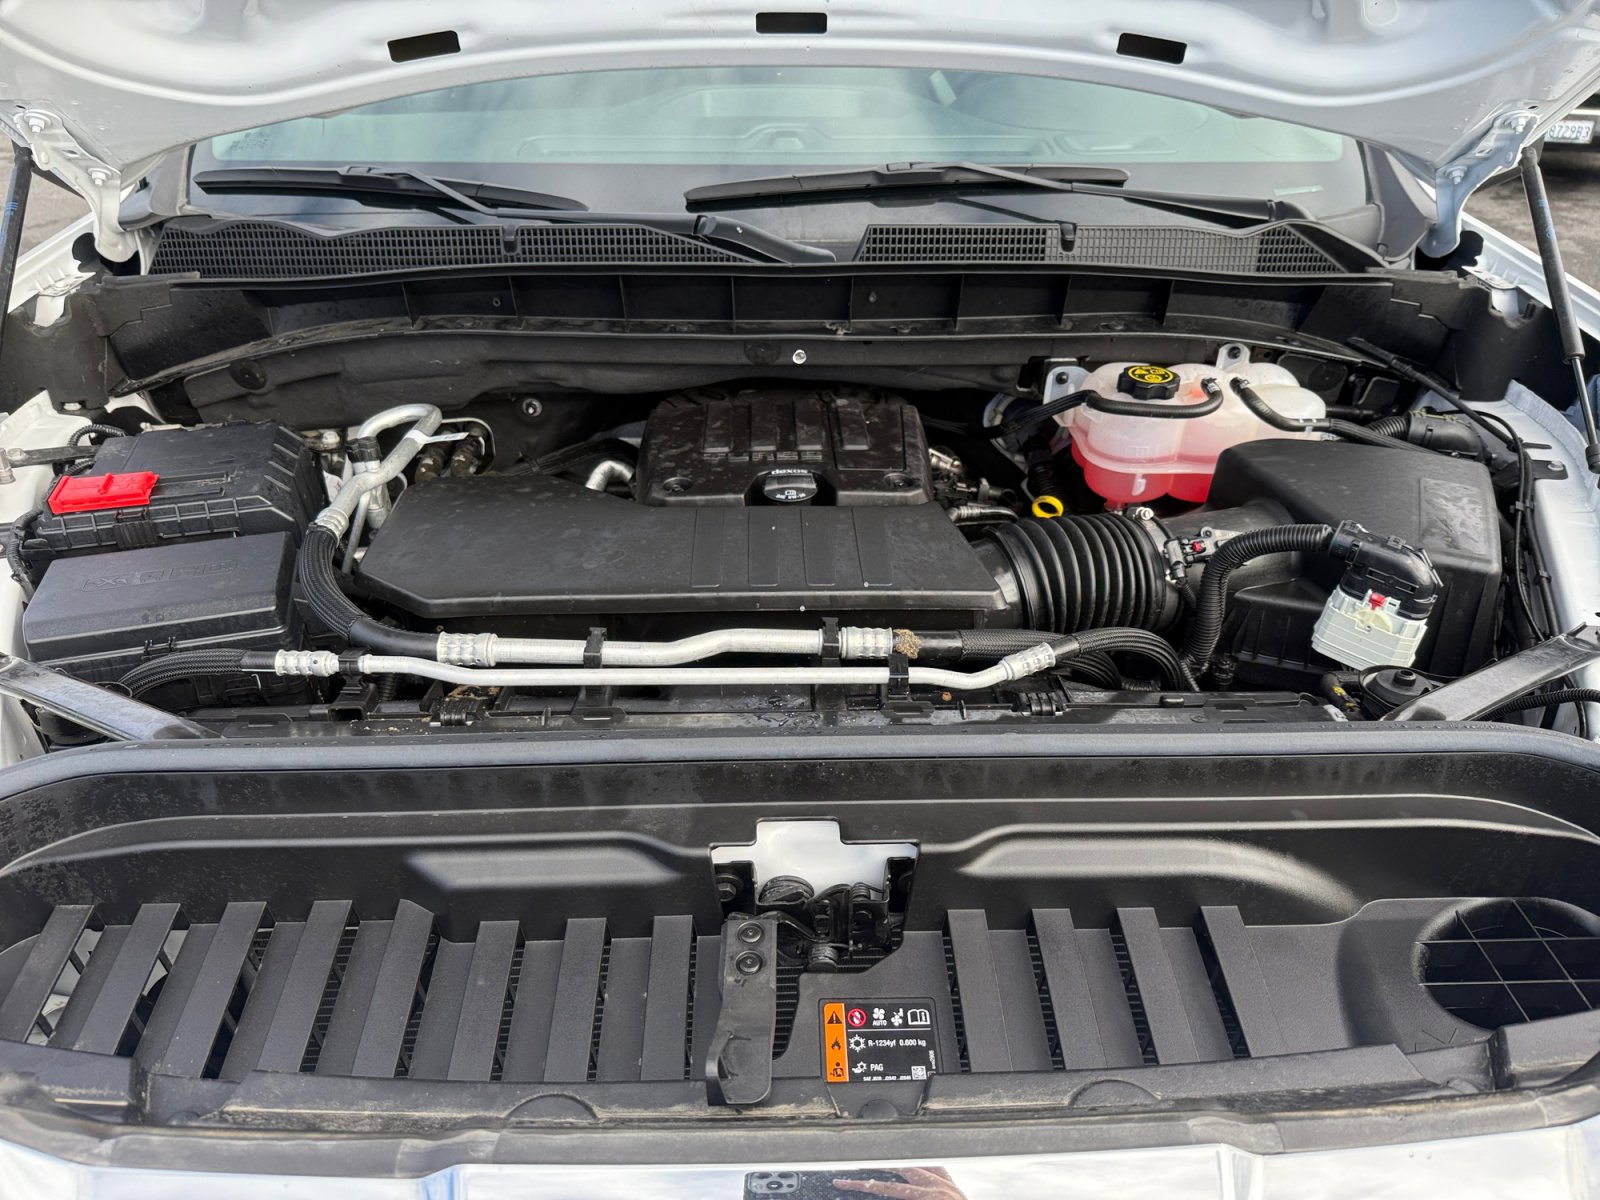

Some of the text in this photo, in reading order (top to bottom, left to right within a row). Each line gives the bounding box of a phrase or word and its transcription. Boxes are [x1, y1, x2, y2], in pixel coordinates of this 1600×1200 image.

[868, 1039, 896, 1048] R-1234yf
[918, 1039, 927, 1048] kg
[870, 1063, 884, 1071] PAG
